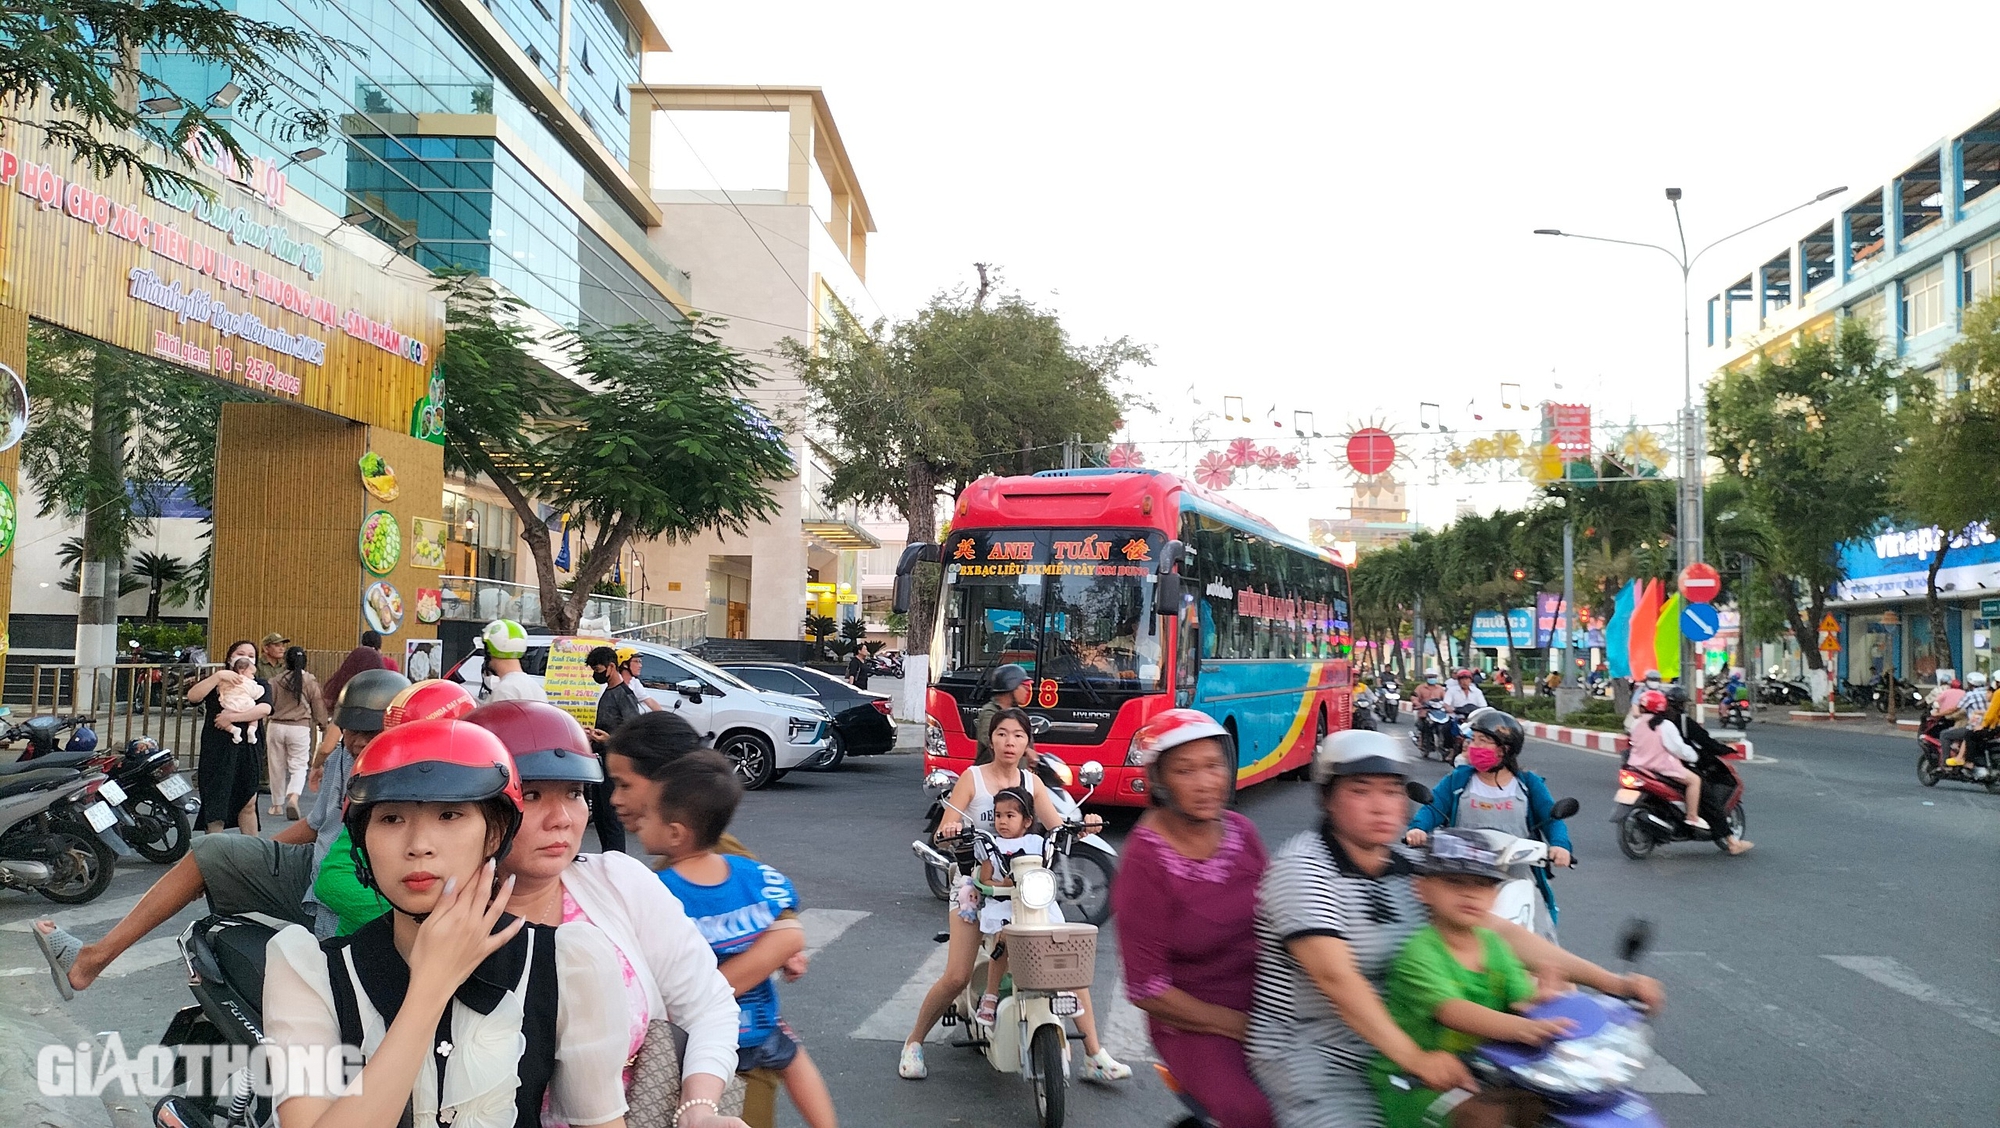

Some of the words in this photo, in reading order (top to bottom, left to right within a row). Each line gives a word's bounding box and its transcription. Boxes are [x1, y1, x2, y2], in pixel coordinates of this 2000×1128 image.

[251, 154, 286, 207] HỘI
[232, 206, 268, 249] Gian
[268, 225, 302, 266] Nam
[302, 243, 324, 281] Bộ
[22, 160, 64, 212] HỘI
[68, 183, 111, 234] CHỢ
[111, 203, 150, 247] XÚC
[152, 221, 190, 265] TIẾN
[192, 240, 216, 276] DU
[217, 252, 255, 299] LỊCH,
[256, 270, 311, 317] THƯƠNG
[311, 296, 337, 332] MẠI
[346, 308, 370, 341] SẢN
[370, 320, 400, 356] PHẨM
[401, 335, 428, 367] OCOP
[130, 267, 182, 312] Thành
[179, 288, 211, 324] phố
[212, 301, 241, 337] Bạc
[240, 312, 268, 344] Liêu
[267, 325, 295, 353] năm
[295, 332, 326, 366] 2025
[155, 330, 181, 356] Thời
[181, 341, 210, 367] gian:
[214, 345, 232, 374] 18
[954, 538, 976, 560] 英
[988, 541, 1034, 560] ANH
[1053, 533, 1112, 560] TUẤN
[997, 561, 1023, 575] LIÊU
[1073, 562, 1096, 576] TÂY
[1095, 565, 1116, 576] KIM
[1475, 615, 1518, 629] PHƯỜG
[1519, 617, 1528, 628] 3
[1072, 711, 1111, 719] HYUNDAI
